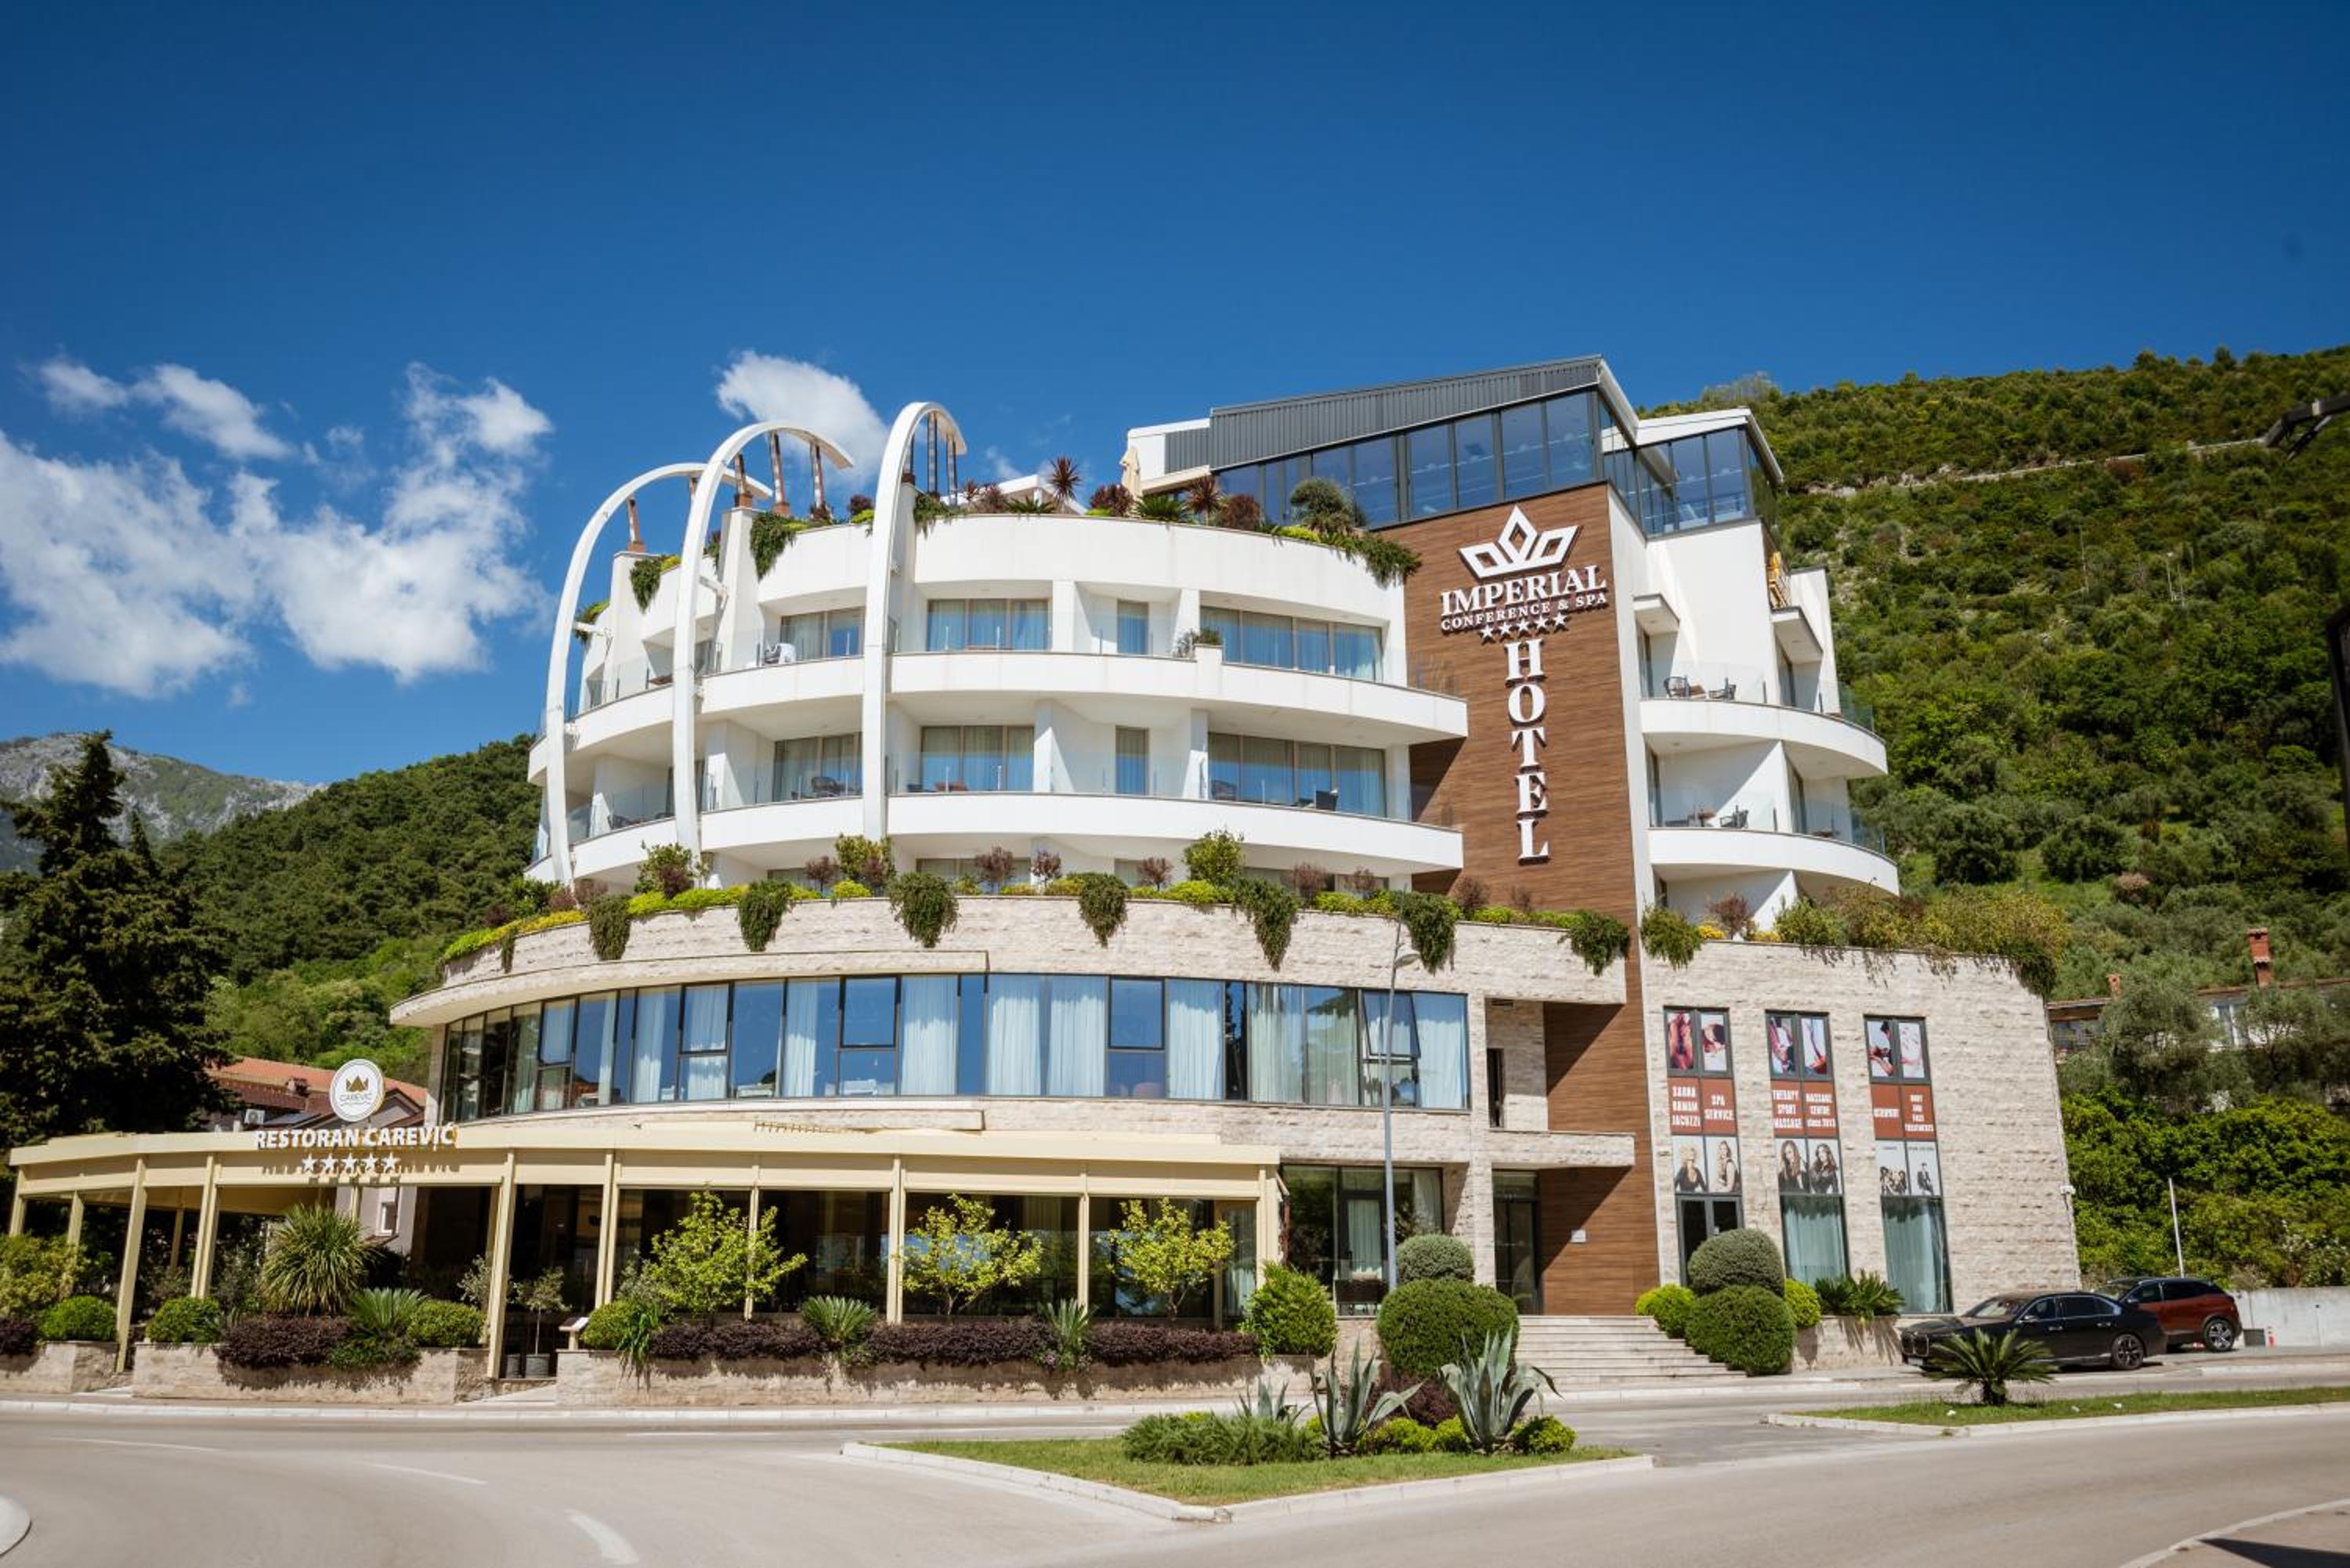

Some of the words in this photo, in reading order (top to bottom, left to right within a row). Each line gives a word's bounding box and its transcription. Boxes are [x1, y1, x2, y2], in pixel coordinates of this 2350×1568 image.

[1441, 565, 1606, 616] IMPERIAL
[1441, 602, 1551, 630] CONFERENCE
[1557, 600, 1569, 611] &
[1575, 593, 1607, 608] SPA
[1504, 638, 1549, 860] HOTEL
[1705, 1108, 1734, 1121] SERVICE
[1711, 1094, 1726, 1106] SPA
[255, 1129, 359, 1148] RESTORAN
[362, 1122, 457, 1147] CAREVIĆ
